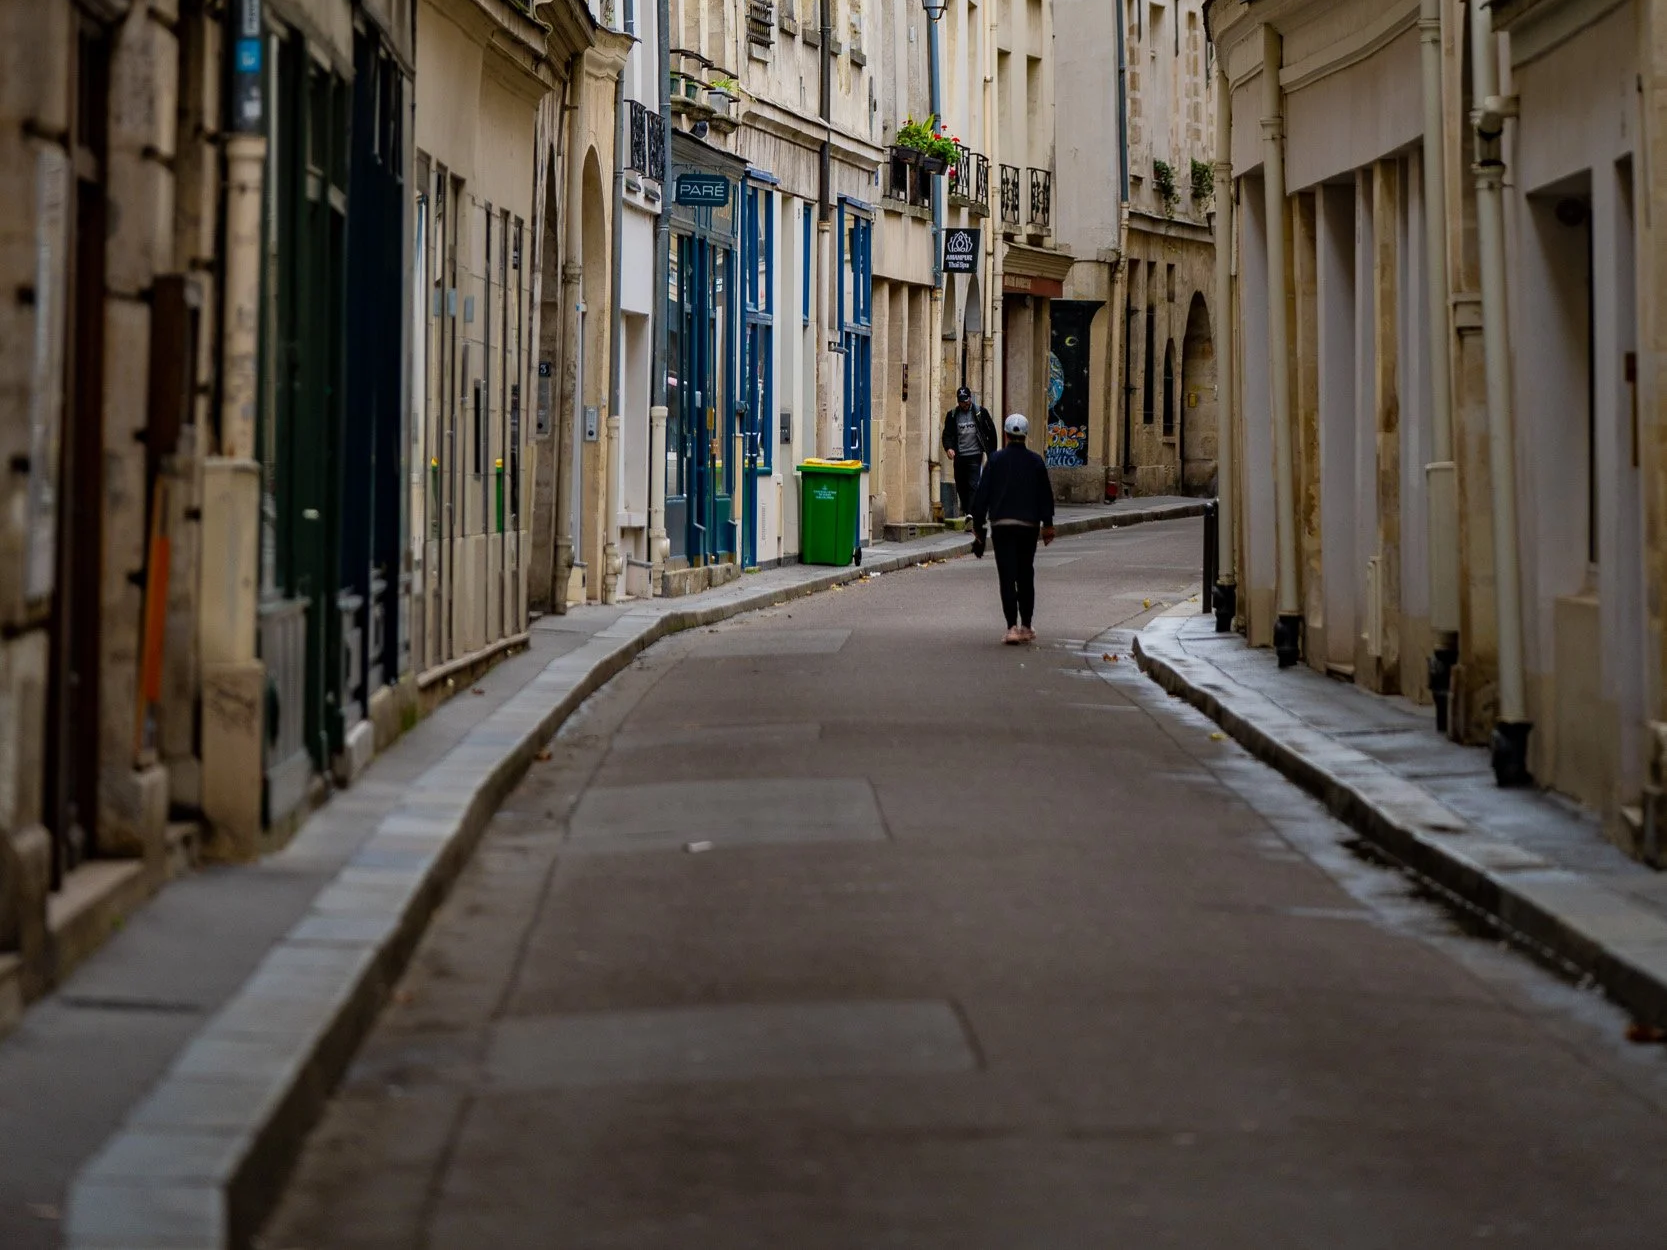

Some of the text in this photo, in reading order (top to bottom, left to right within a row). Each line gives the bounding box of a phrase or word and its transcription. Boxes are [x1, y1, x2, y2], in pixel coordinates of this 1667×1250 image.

[680, 183, 725, 197] PARÉ
[959, 261, 970, 270] Spa
[540, 364, 547, 374] 3
